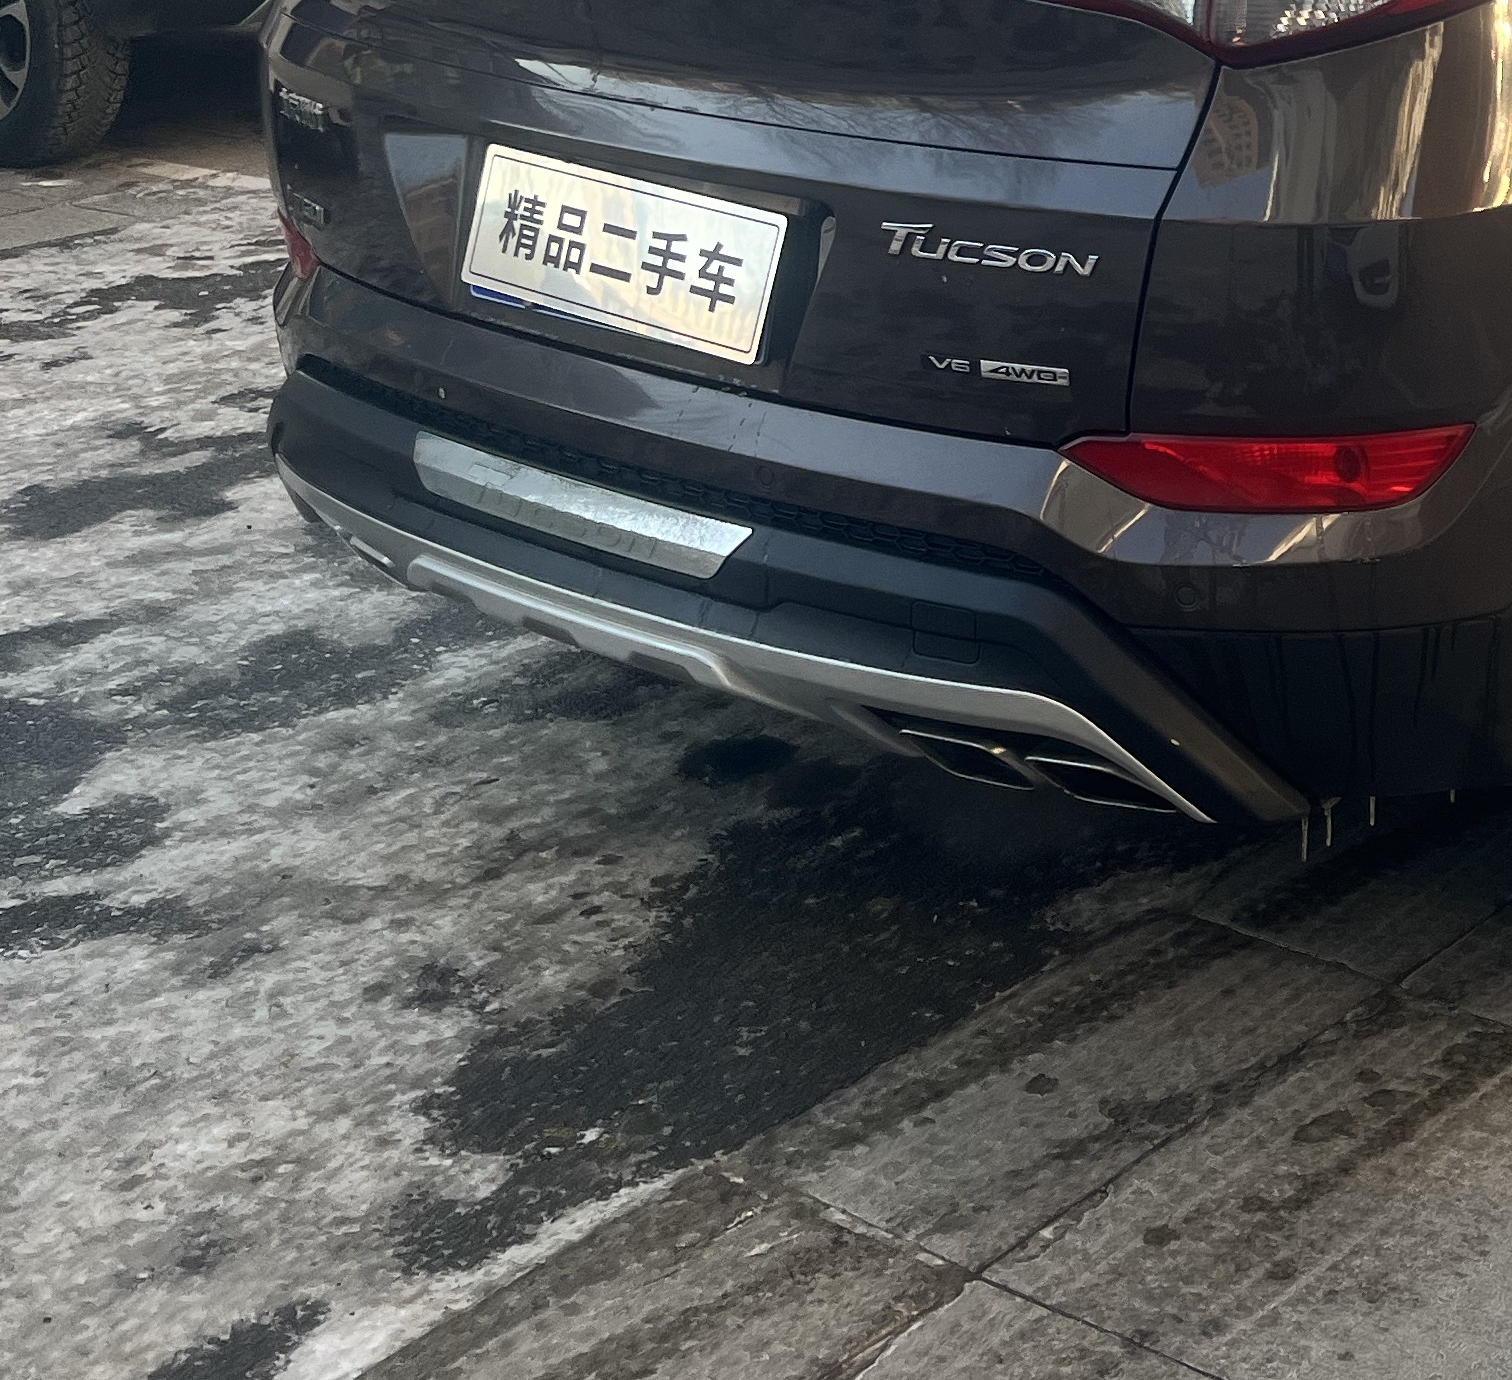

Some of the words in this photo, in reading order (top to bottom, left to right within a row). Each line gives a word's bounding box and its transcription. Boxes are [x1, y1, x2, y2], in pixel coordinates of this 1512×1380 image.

[499, 189, 744, 313] 精品二手车
[881, 222, 1099, 277] TUCSON
[988, 365, 1058, 382] 4WD
